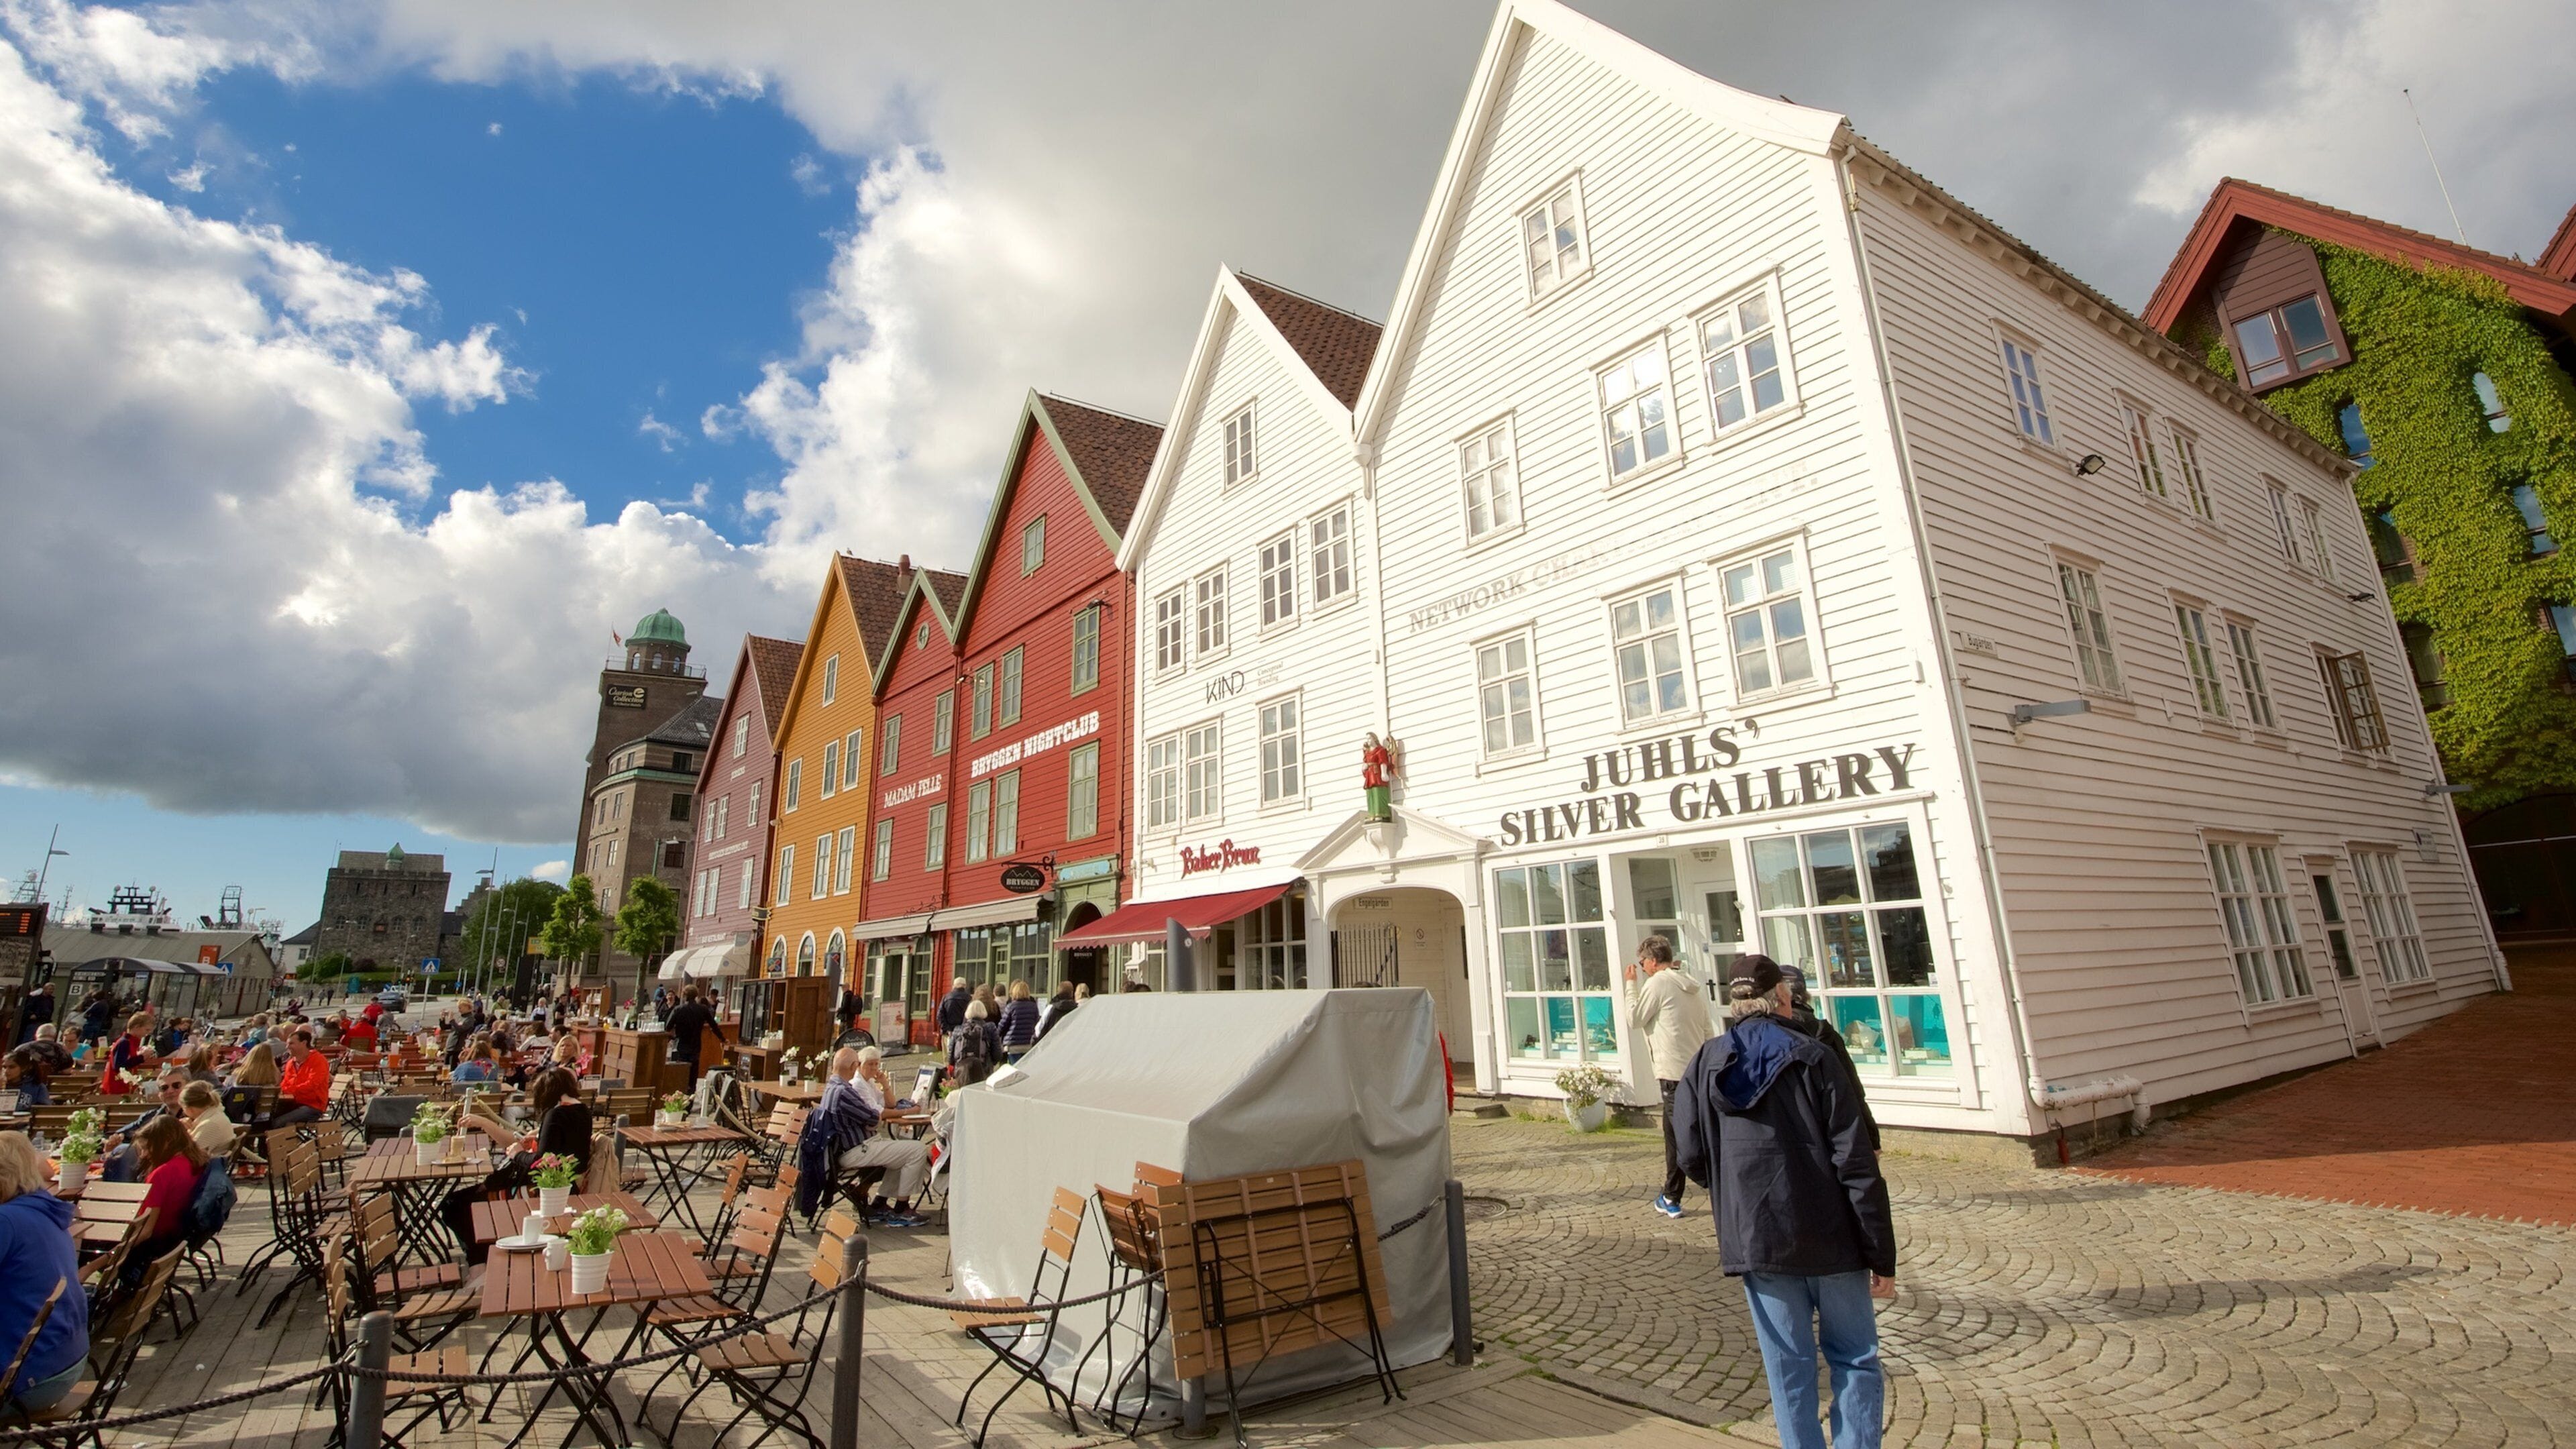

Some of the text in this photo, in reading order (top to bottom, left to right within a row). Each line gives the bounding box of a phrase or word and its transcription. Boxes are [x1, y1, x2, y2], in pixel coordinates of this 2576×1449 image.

[1409, 571, 1527, 634] NETWORK
[608, 686, 633, 697] Clarion
[612, 695, 645, 704] Collection
[1206, 670, 1244, 704] KIND
[971, 710, 1100, 779] BRYGGEN NIGHTCLUB
[883, 773, 943, 809] MADAM FELLE
[1500, 743, 1917, 847] SILVER GALLERY
[1179, 838, 1261, 879] Baker Brun
[1006, 877, 1040, 886] BRYGGEN
[72, 985, 80, 994] B
